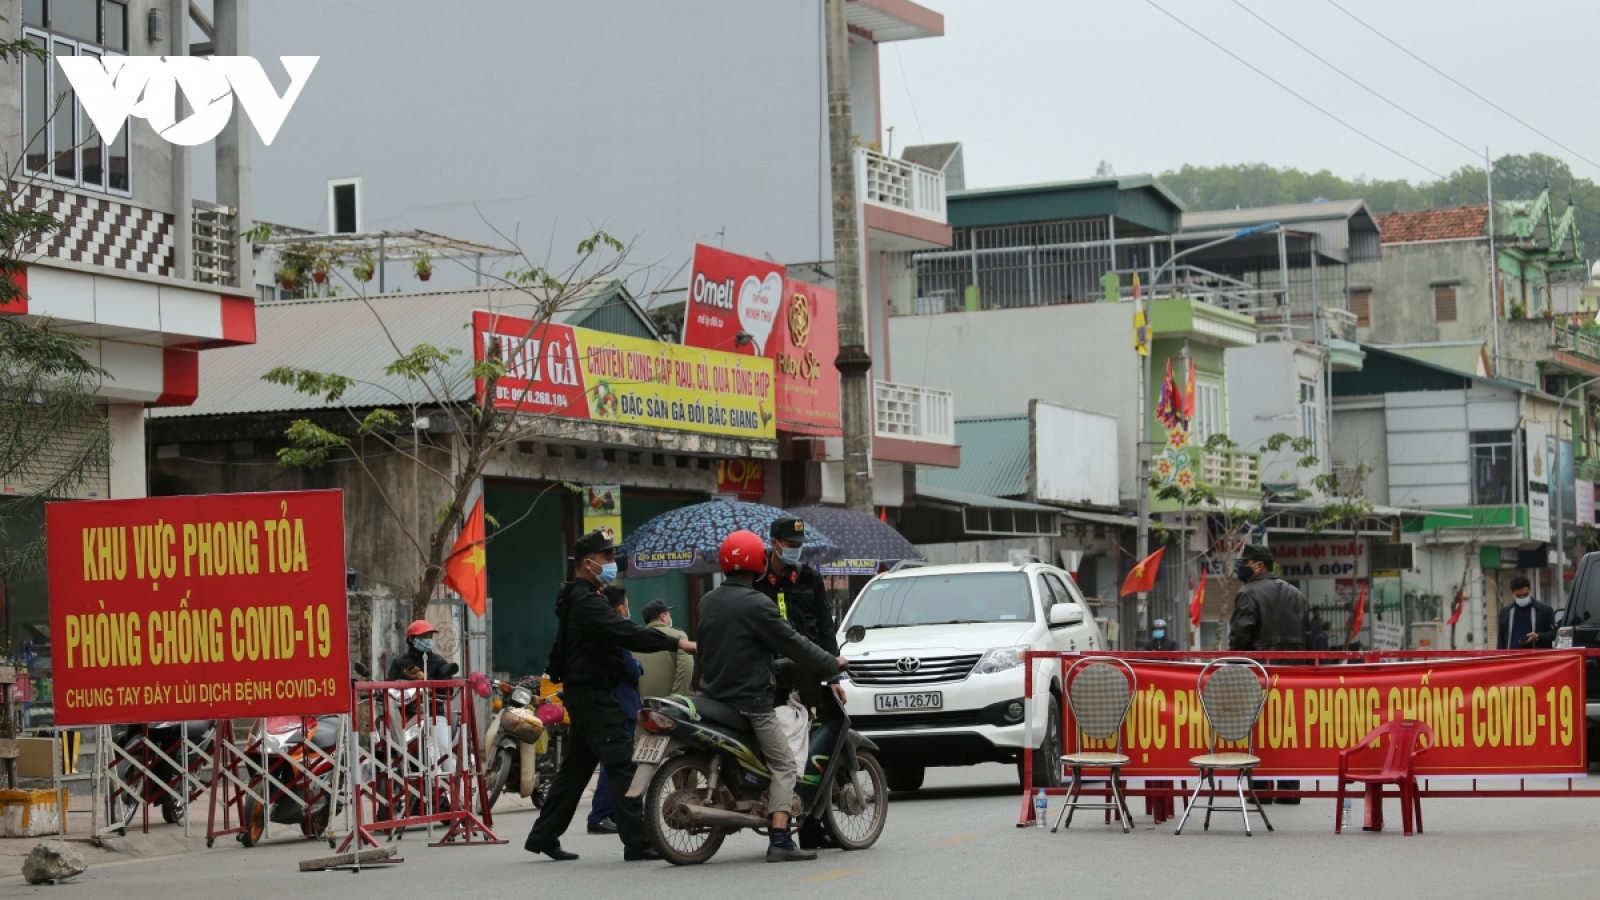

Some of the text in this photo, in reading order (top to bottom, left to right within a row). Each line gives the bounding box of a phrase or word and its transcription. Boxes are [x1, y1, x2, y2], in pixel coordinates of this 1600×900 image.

[693, 272, 735, 310] Omeli
[547, 332, 579, 386] GÀ
[586, 344, 625, 378] CHUYÊN
[627, 351, 652, 382] CUNG
[675, 360, 696, 392] RAU,
[713, 358, 730, 395] QUẢ
[621, 392, 643, 420] ĐẶC
[647, 393, 669, 420] SẢN
[708, 400, 727, 427] BẮC
[730, 408, 758, 430] GIANG
[82, 500, 309, 592] KHU VỰC PHONG TỎA
[651, 551, 692, 561] KIM TRANG
[1280, 560, 1313, 576] TRẢ
[1319, 560, 1353, 576] GÓP
[66, 589, 331, 669] PHÒNG CHỐNG COVID-19
[66, 687, 114, 708] CHUNG
[117, 687, 141, 705] TAY
[175, 679, 196, 704] LÙI
[200, 683, 231, 707] DỊCH
[235, 678, 272, 705] BỆNH
[275, 678, 336, 700] COVID-19
[1125, 684, 1168, 763] VỰC
[1304, 676, 1381, 749] PHÒNG
[1472, 685, 1573, 748] COVID-19
